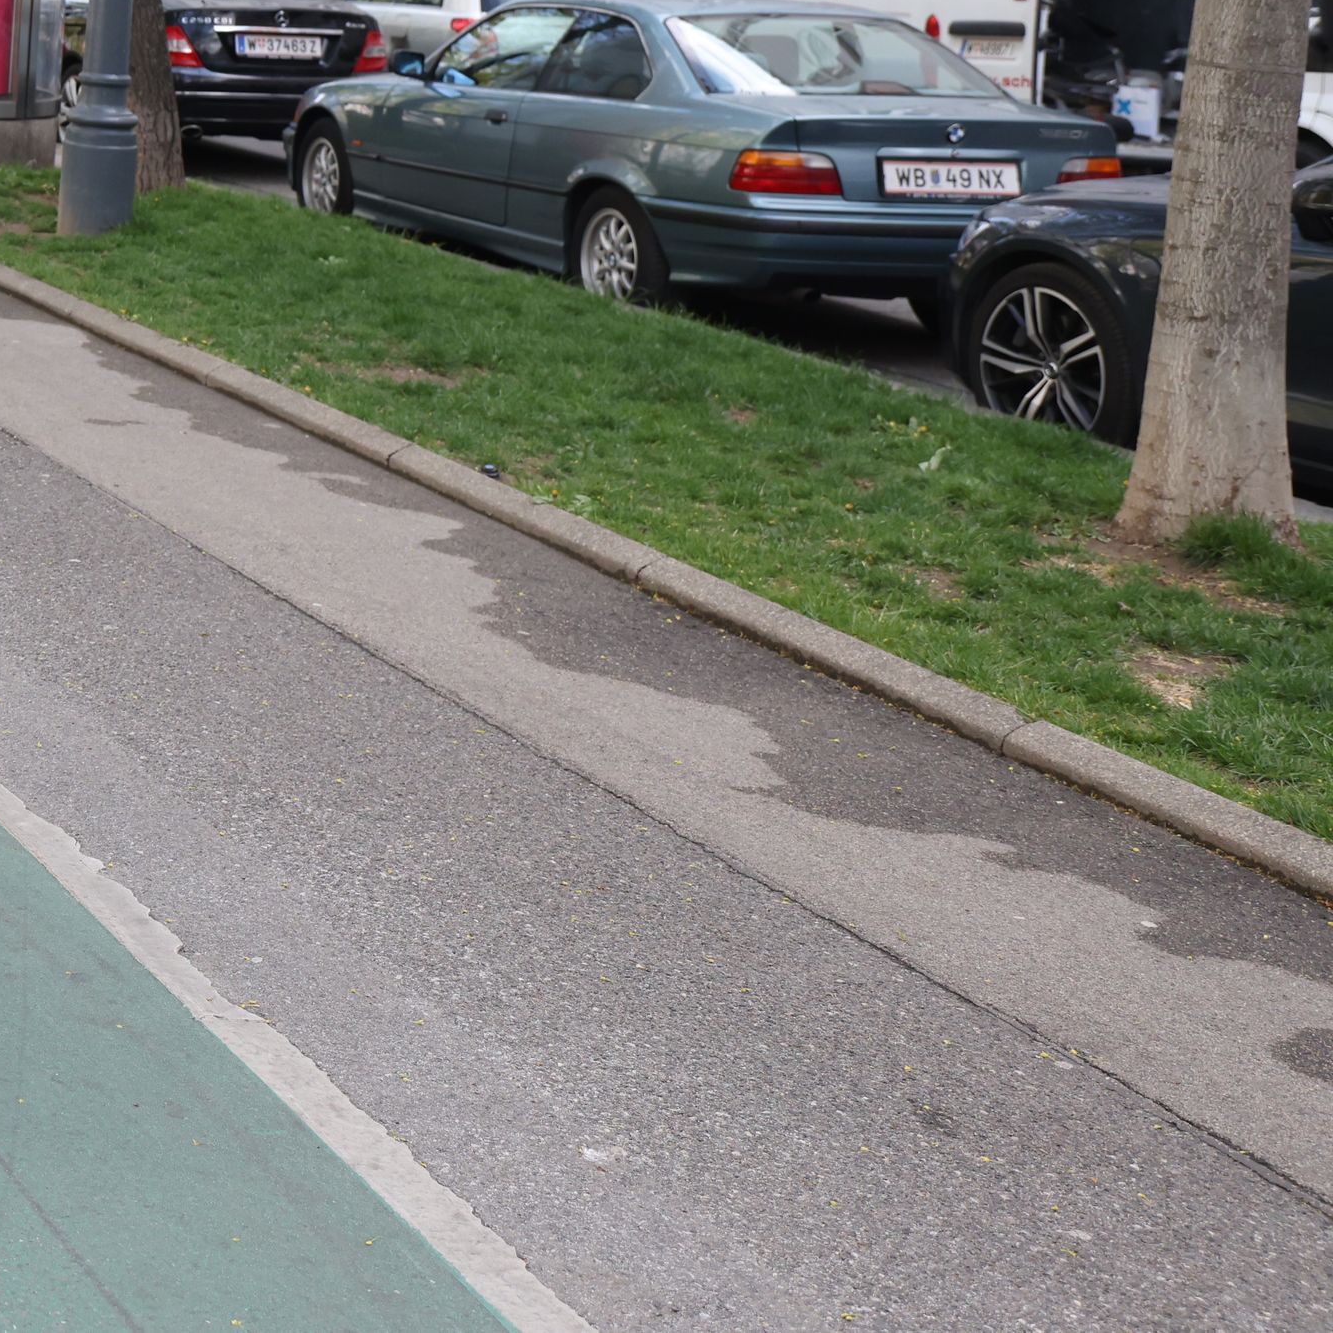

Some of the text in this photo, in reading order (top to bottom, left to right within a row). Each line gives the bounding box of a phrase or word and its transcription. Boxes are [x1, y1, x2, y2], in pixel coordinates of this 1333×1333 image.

[247, 38, 257, 50] W
[895, 167, 1005, 189] WB 49 NX
